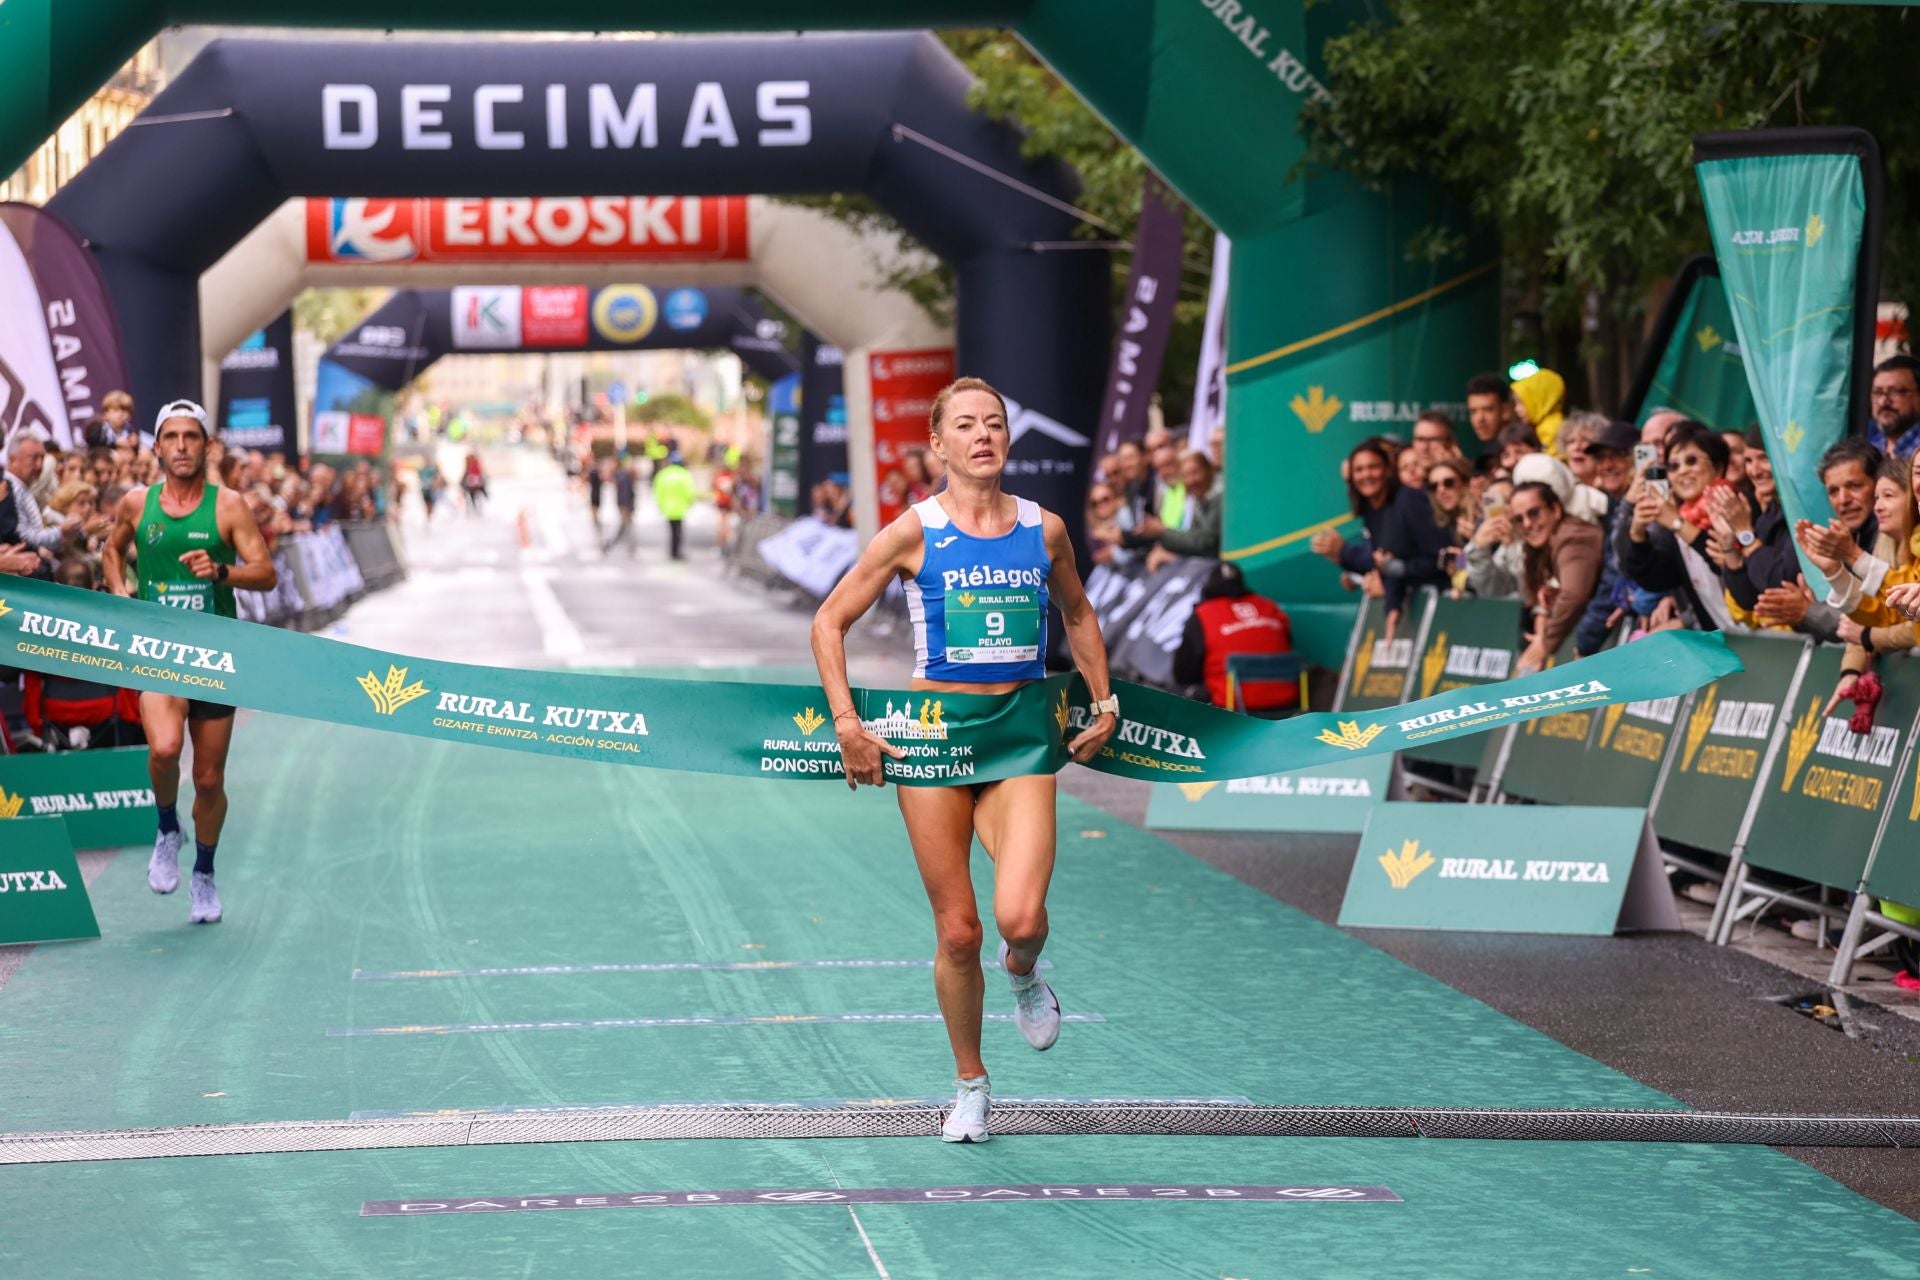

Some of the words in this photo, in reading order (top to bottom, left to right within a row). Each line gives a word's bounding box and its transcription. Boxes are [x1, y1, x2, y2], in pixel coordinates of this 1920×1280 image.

[322, 80, 812, 150] DECIMAS
[443, 196, 701, 246] EROSKI
[979, 596, 1003, 604] RURAL
[1005, 595, 1030, 604] KUTXA
[985, 612, 1005, 636] 9
[19, 611, 120, 650] RURAL
[128, 634, 236, 673] KUTXA
[978, 638, 1012, 647] PELAYO
[17, 642, 68, 661] GIZARTE
[72, 652, 123, 672] EKINTZA
[132, 664, 180, 682] ACCIÓN
[183, 674, 227, 690] SOCIAL
[436, 691, 535, 723] RURAL
[543, 705, 649, 736] KUTXA
[1397, 702, 1498, 732] RURAL
[1501, 680, 1611, 709] KUTXA
[432, 717, 483, 733] GIZARTE
[487, 725, 538, 740] EKINTZA
[546, 733, 594, 747] ACCIÓN
[597, 739, 641, 753] SOCIAL
[1117, 718, 1206, 759] KUTXA
[1406, 724, 1458, 740] GIZARTE
[764, 739, 801, 751] RURAL
[804, 741, 842, 753] KUTXA
[893, 744, 939, 757] RATÓN
[950, 745, 973, 757] 21K
[761, 757, 846, 774] DONOSTIA
[884, 760, 975, 779] SEBASTIÁN
[1119, 752, 1160, 769] ACCIÓN
[1162, 761, 1206, 773] SOCIAL
[1225, 777, 1295, 795] RURAL
[1297, 776, 1371, 797] KUTXA
[30, 792, 94, 814] RURAL
[93, 788, 156, 810] KUTXA
[1438, 857, 1518, 880] RURAL
[1522, 860, 1610, 883] KUTXA
[400, 1194, 721, 1212] DARE2B
